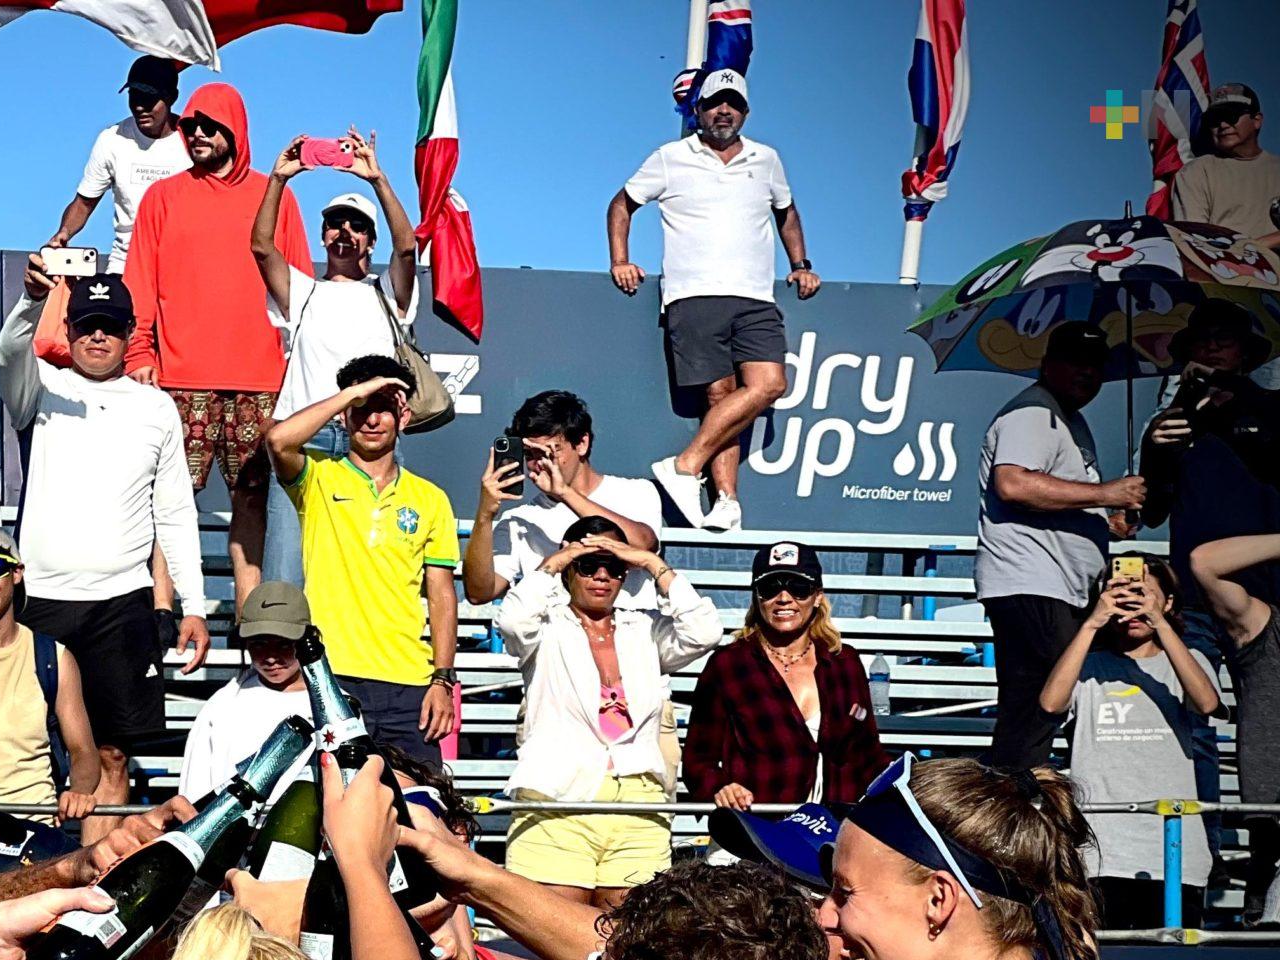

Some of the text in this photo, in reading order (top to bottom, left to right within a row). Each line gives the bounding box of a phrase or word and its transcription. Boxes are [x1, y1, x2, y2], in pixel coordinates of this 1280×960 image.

[770, 331, 914, 435] dry
[748, 416, 856, 497] up
[842, 485, 952, 502] Microfiber towel
[1097, 702, 1134, 724] EY
